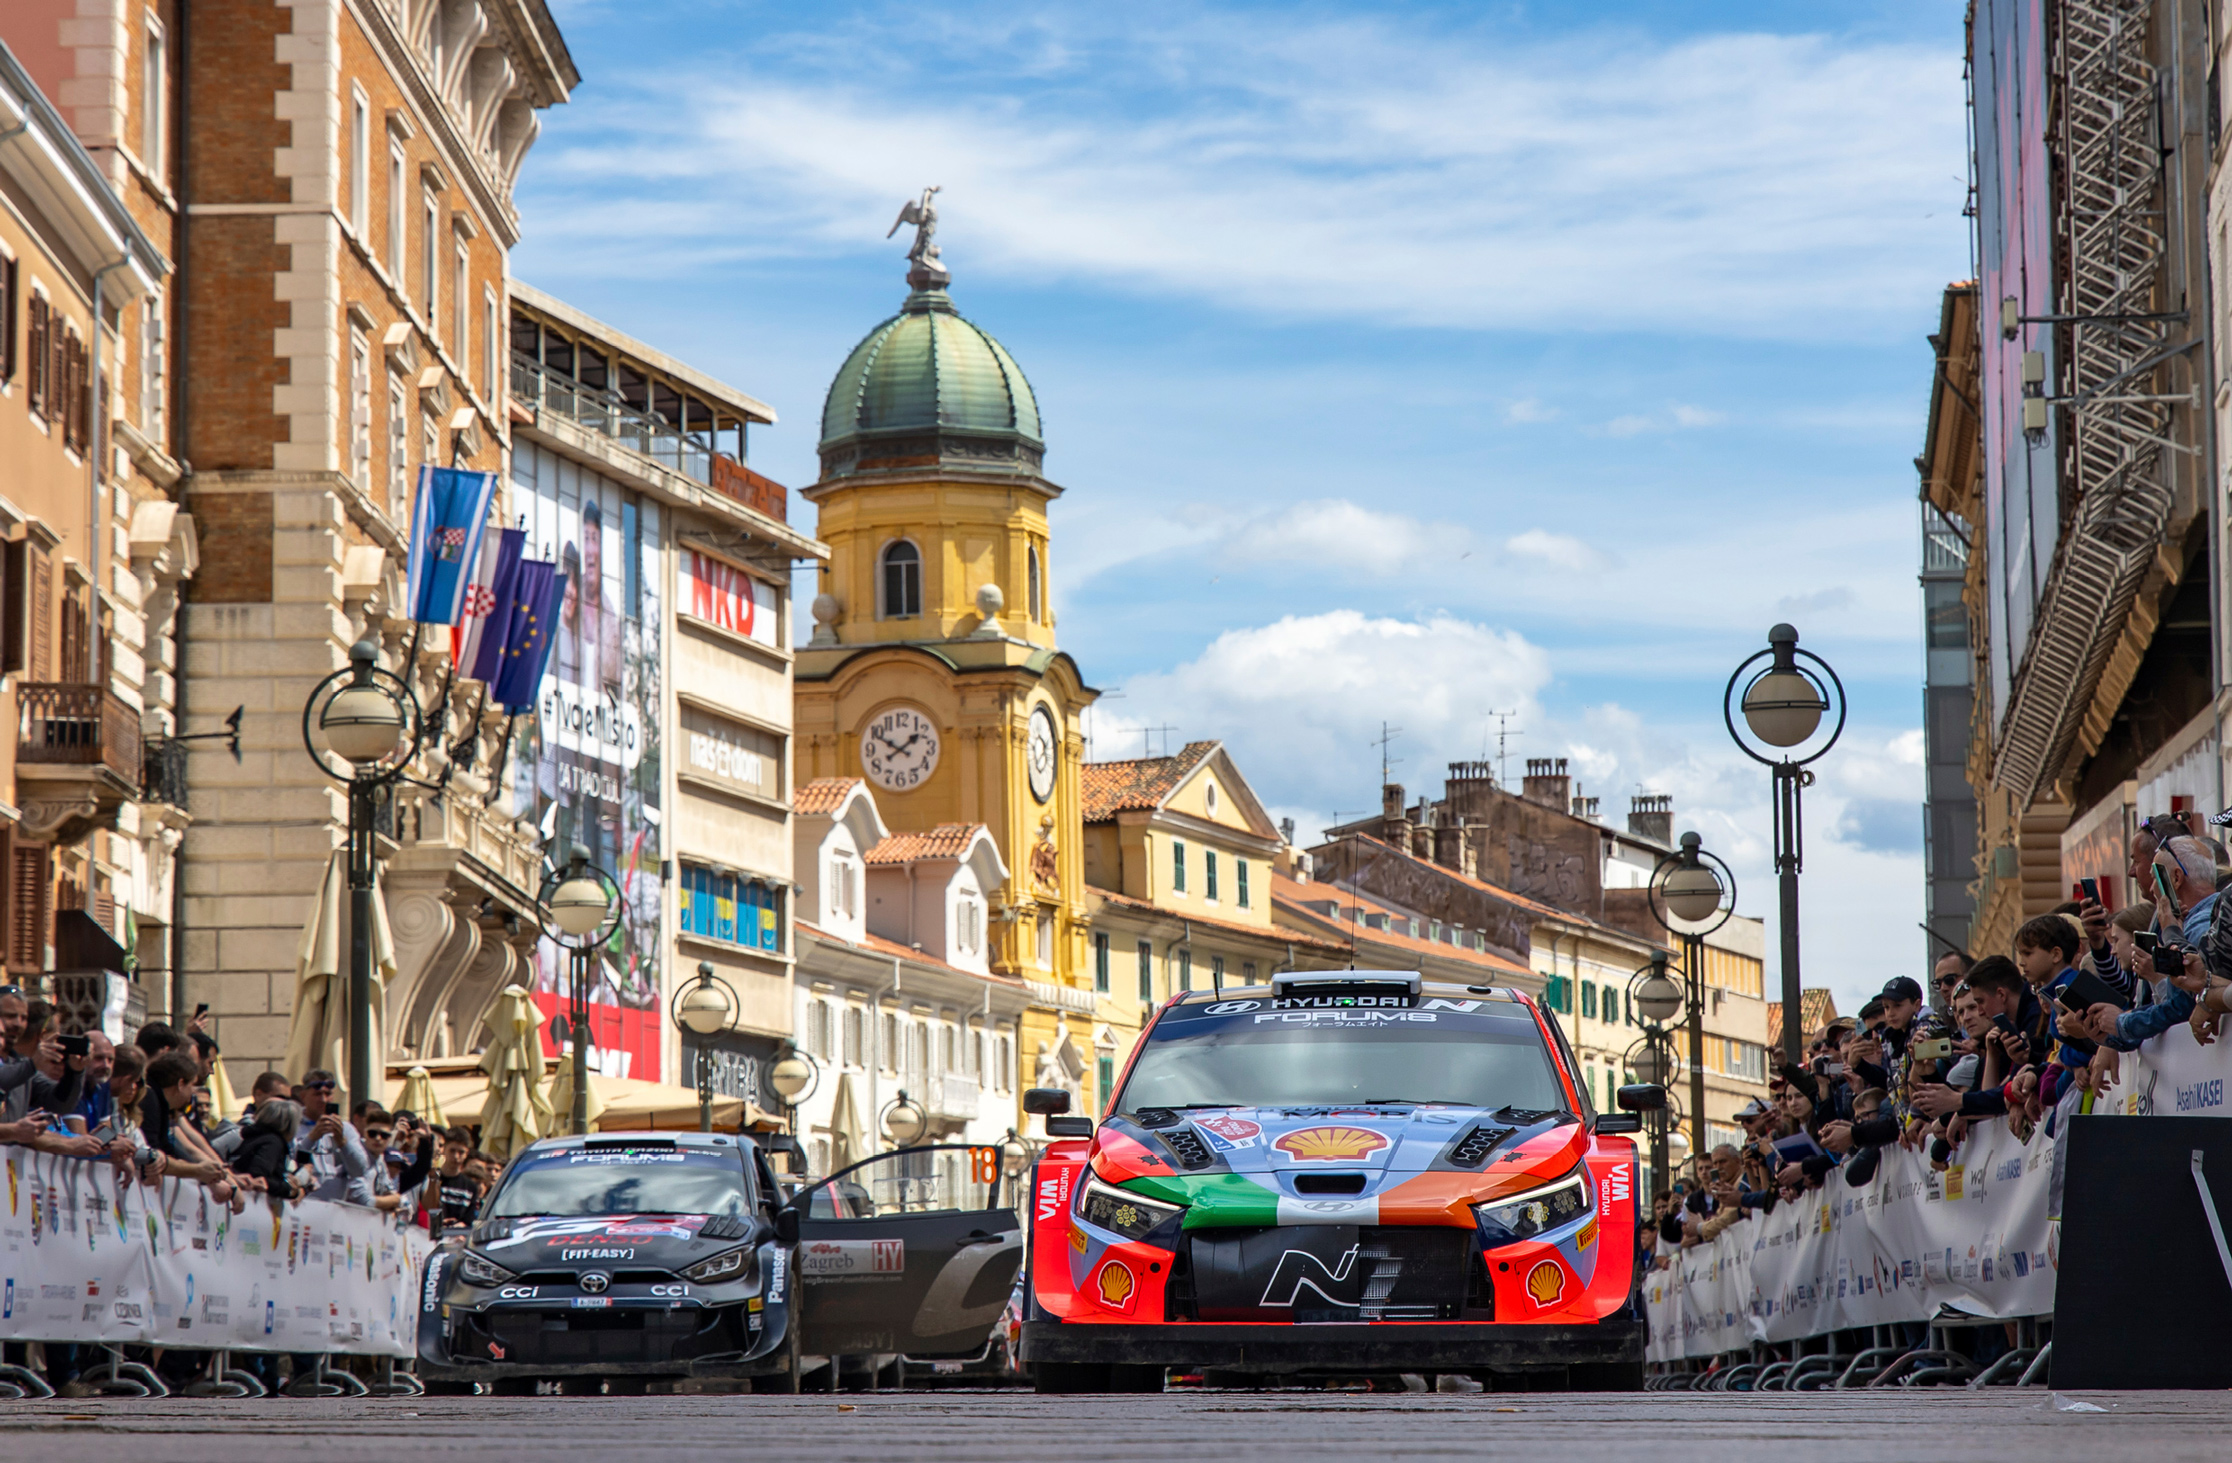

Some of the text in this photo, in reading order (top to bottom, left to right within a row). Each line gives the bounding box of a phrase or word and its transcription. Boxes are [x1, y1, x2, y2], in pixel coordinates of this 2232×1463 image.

[692, 551, 754, 638] NKD
[884, 716, 893, 732] 11
[896, 712, 909, 729] 12
[914, 716, 919, 732] 1
[871, 725, 884, 741] 10
[920, 724, 929, 740] 2
[865, 742, 876, 758] 9
[926, 740, 936, 757] 3
[871, 759, 882, 776] 8
[921, 755, 930, 771] 4
[884, 769, 893, 785] 7
[895, 771, 906, 787] 6
[909, 767, 919, 784] 5
[1271, 996, 1409, 1009] HYUNDAI
[1254, 1011, 1438, 1025] FORUM8
[1282, 1110, 1458, 1125] MOBIS
[569, 1153, 686, 1164] FORUM8
[968, 1146, 998, 1184] 18
[1058, 1167, 1070, 1202] HYUNDAI
[1601, 1179, 1611, 1216] HYUNDAI
[547, 1234, 654, 1246] DENSO
[873, 1241, 902, 1271] HY
[767, 1246, 787, 1304] Panasoni
